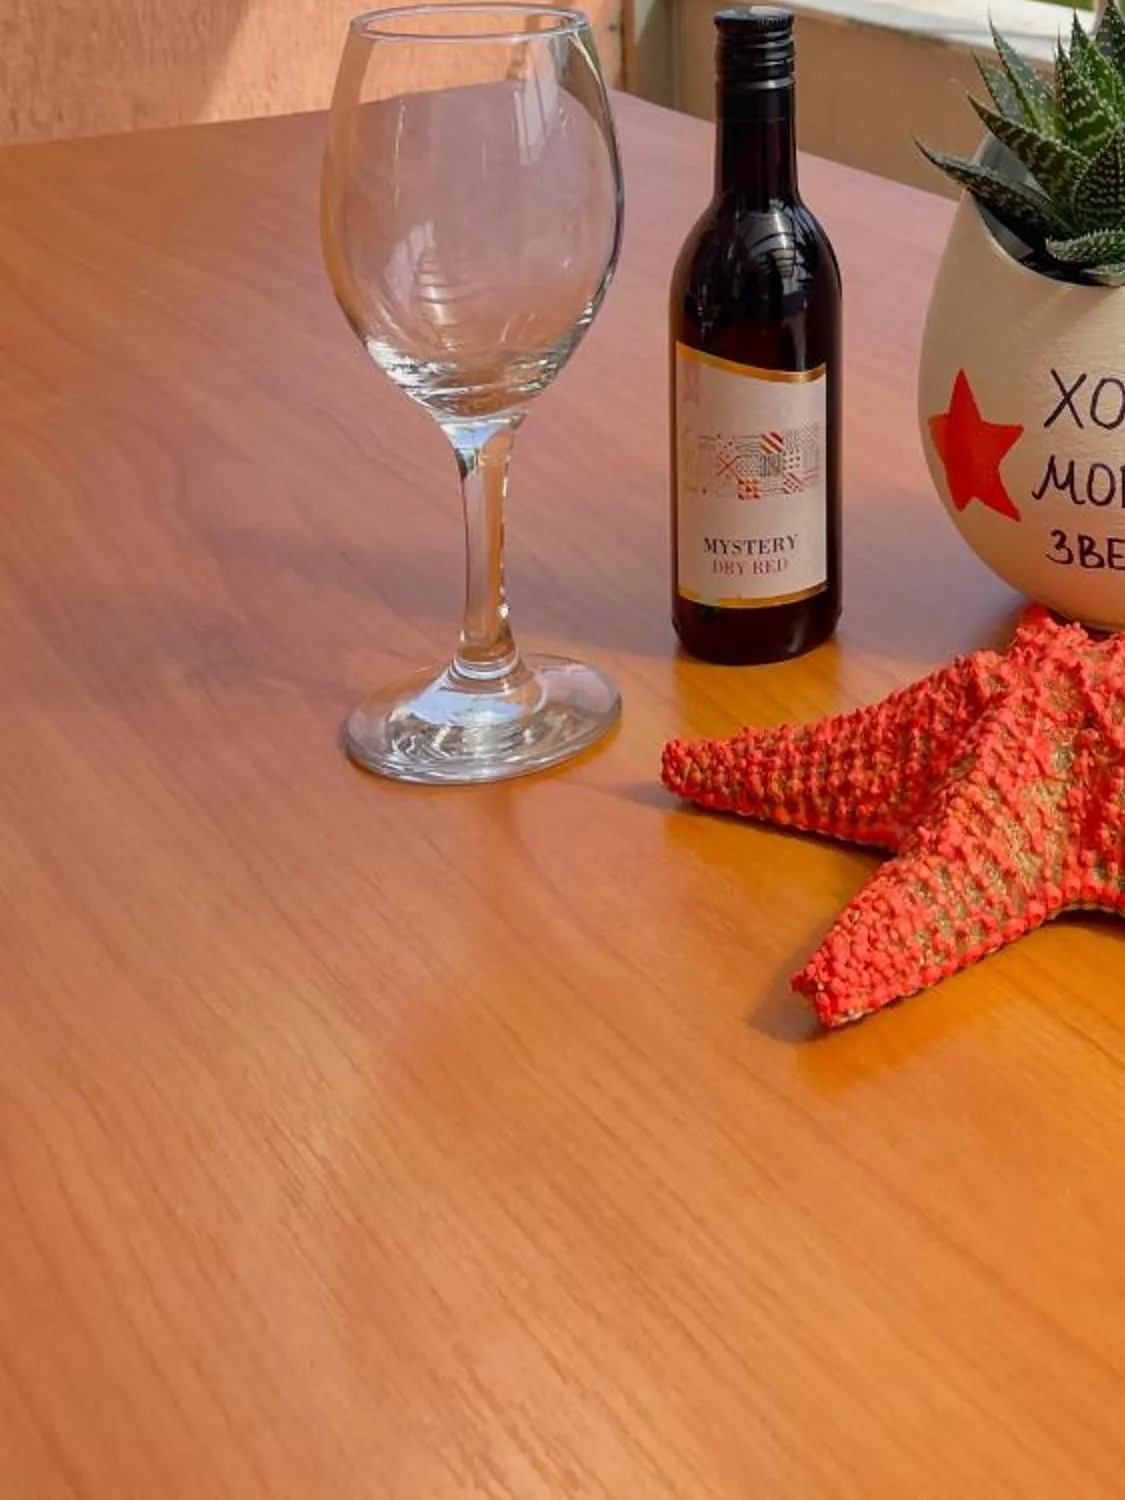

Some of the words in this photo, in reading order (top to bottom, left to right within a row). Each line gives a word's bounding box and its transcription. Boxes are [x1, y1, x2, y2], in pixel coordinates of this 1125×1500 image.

[703, 533, 799, 556] MYSTERY
[713, 559, 745, 575] DRY
[753, 557, 788, 575] RED
